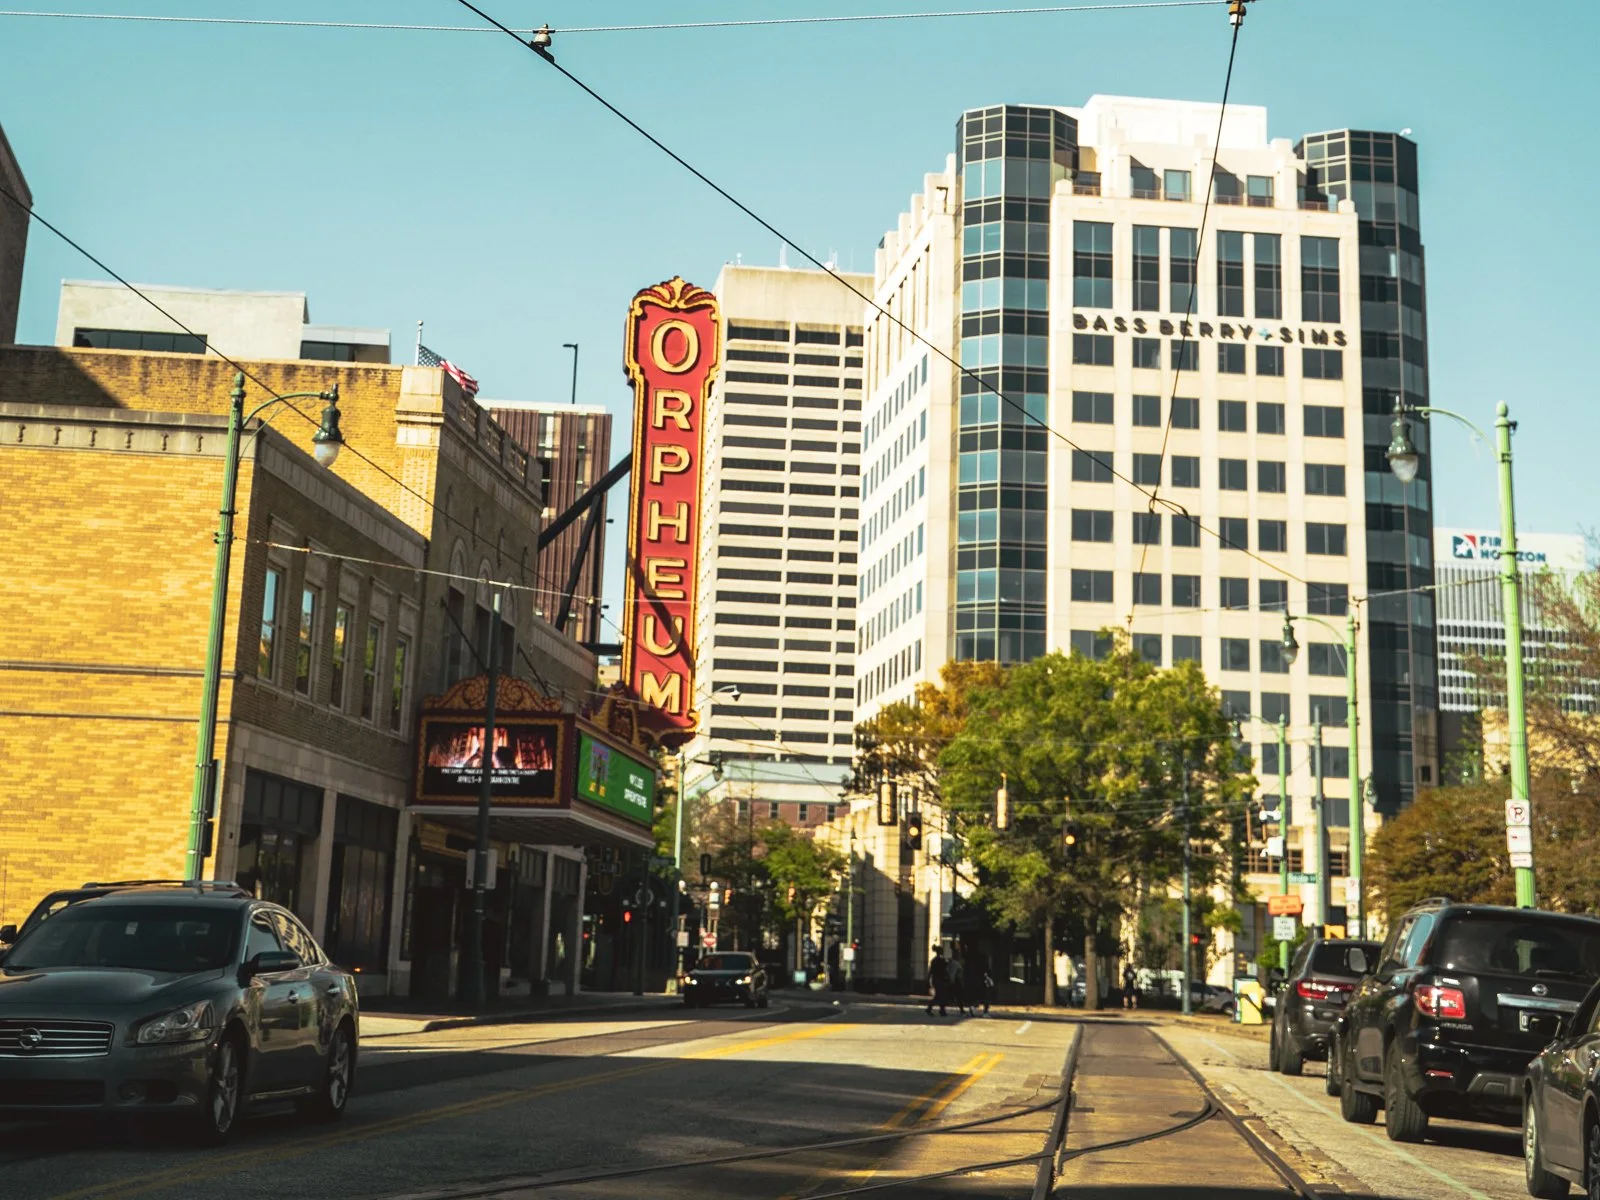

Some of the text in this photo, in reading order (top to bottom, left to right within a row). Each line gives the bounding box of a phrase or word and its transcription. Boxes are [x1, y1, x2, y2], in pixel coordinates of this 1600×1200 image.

[1072, 313, 1148, 334] BASS
[1159, 319, 1253, 340] BERRY
[1279, 326, 1347, 347] SIMS
[640, 318, 699, 714] ORPHEUM
[1480, 550, 1546, 562] HOZON
